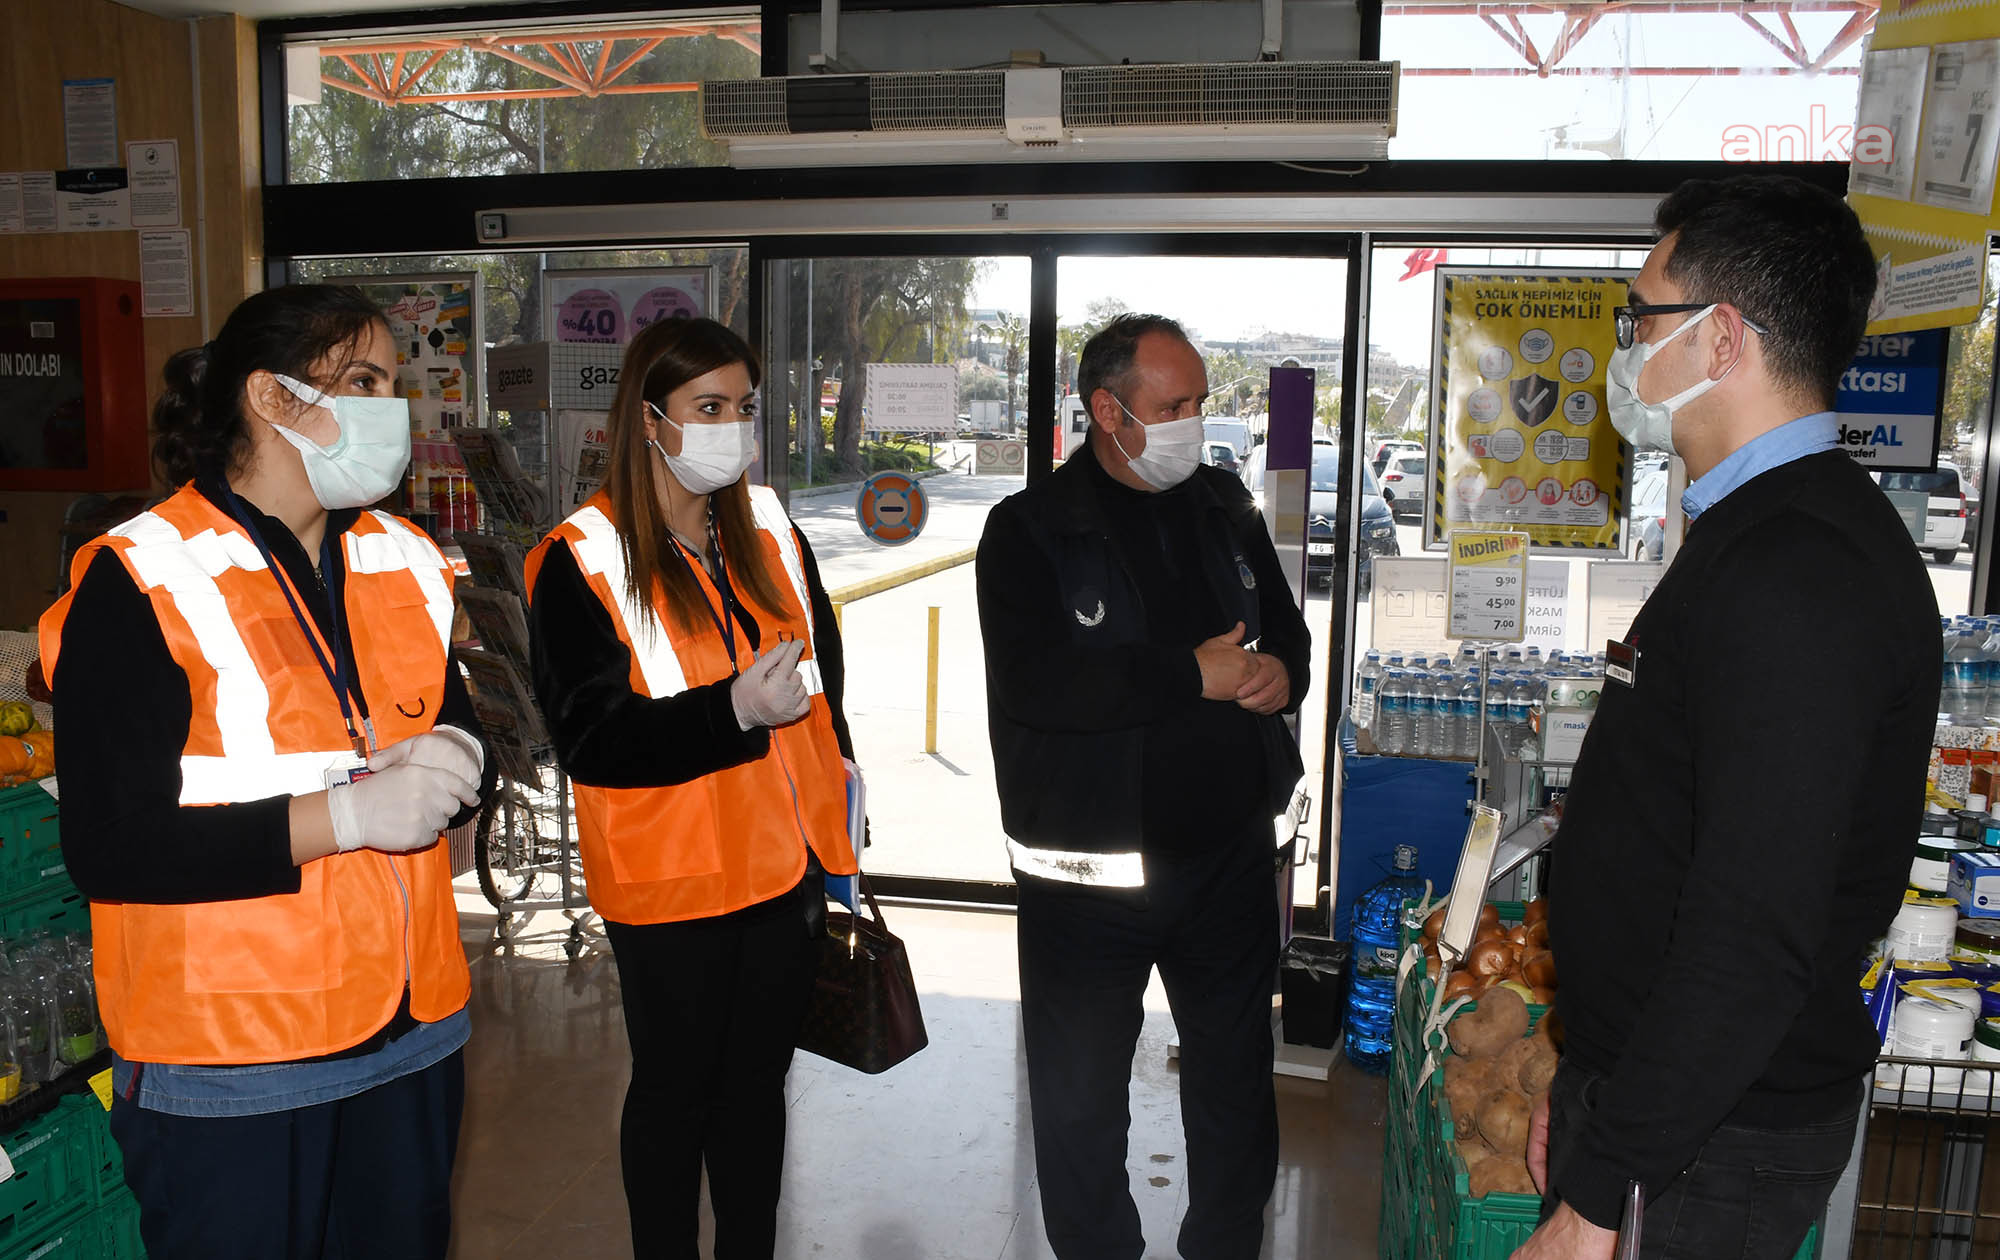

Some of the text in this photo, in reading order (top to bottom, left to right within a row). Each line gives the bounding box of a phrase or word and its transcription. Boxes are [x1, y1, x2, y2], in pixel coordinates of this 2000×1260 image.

[1475, 287, 1602, 303] SAĞLIK HEPİMİZ İÇİN
[562, 308, 616, 336] %40
[1475, 301, 1601, 321] ÇOK ÖNEMLİ!
[1856, 335, 1915, 358] sfer
[0, 352, 61, 377] IN DOLABI
[497, 366, 534, 392] gazete
[579, 365, 621, 390] gaz
[1836, 423, 1905, 447] derAL
[1848, 448, 1877, 459] nsferi
[1458, 536, 1520, 558] İNDİRİM
[1563, 721, 1587, 730] mask
